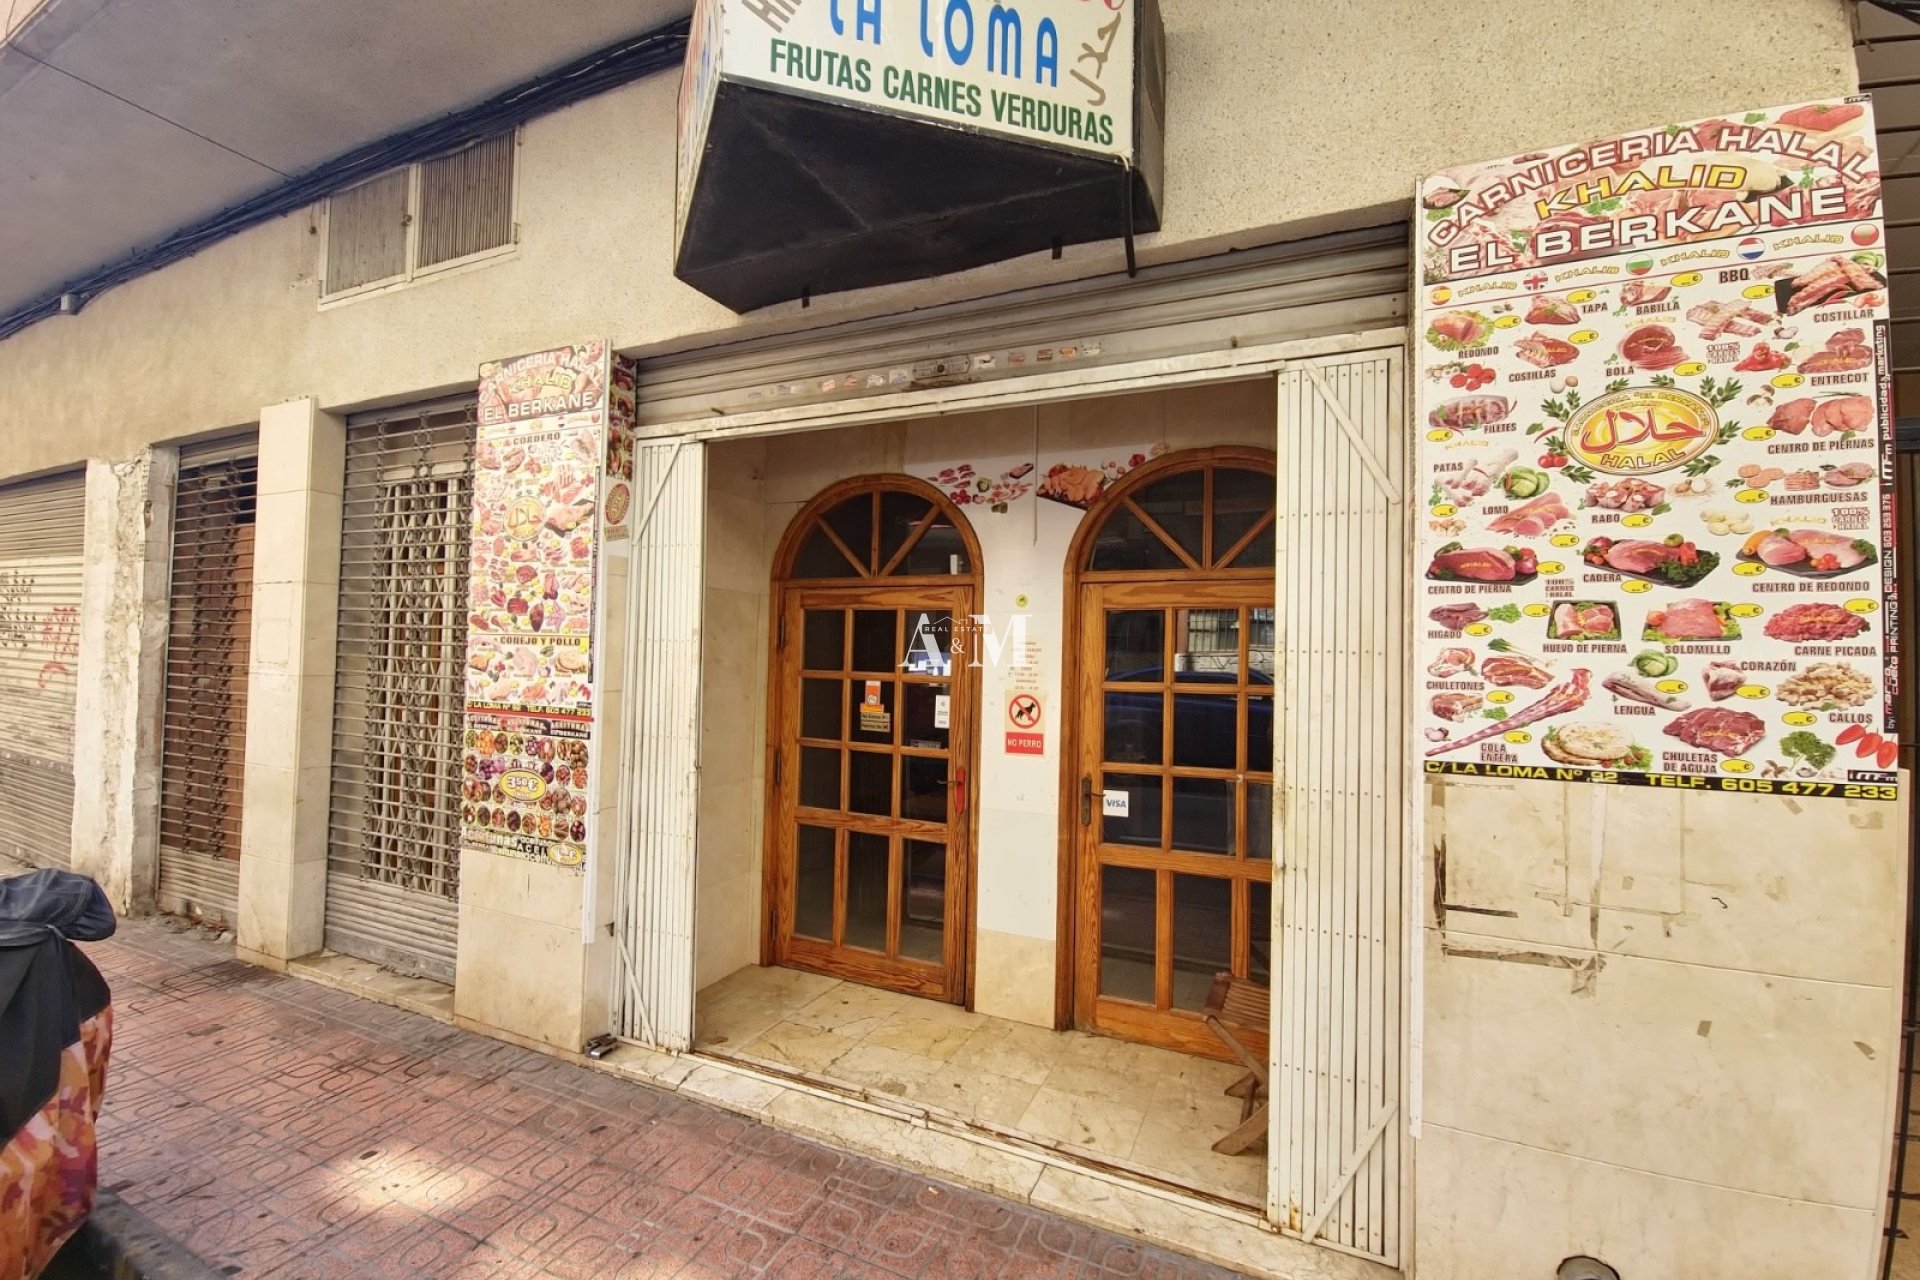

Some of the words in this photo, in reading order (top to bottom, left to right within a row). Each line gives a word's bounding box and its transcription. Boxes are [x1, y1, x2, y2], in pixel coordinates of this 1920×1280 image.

[830, 0, 882, 45] LA
[920, 0, 1058, 88] LOMA
[769, 38, 872, 93] FRUTAS
[882, 66, 982, 117] CARNES
[991, 90, 1114, 146] VERDURAS
[1428, 127, 1701, 247] CARNICERIA
[1716, 126, 1872, 184] HALAL
[1535, 164, 1748, 220] KHALID
[1449, 243, 1517, 275] EL
[1535, 187, 1849, 264] BERKANE
[1660, 248, 1731, 267] KHALID
[1772, 233, 1845, 251] KHALID
[1719, 267, 1750, 284] BBQ
[1582, 302, 1608, 314] TAPA
[1636, 301, 1680, 317] BABILLA
[1813, 308, 1875, 324] COSTILLAR
[1458, 346, 1500, 360] REDONDO
[1508, 369, 1557, 383] COSTILLAS
[1605, 365, 1635, 378] BOLA
[509, 369, 572, 394] KHALID
[1810, 372, 1869, 387] ENTRECOT
[484, 405, 503, 421] EL
[508, 390, 594, 417] BERKANE
[1484, 423, 1517, 435] FILETES
[1768, 442, 1810, 455] CENTRO
[1812, 441, 1826, 451] DE
[1829, 438, 1875, 451] PIERNAS
[1600, 449, 1687, 469] HALAL
[1433, 462, 1464, 473] PATAS
[1770, 492, 1868, 506] HAMBURGUESAS
[1482, 505, 1509, 515] LOMO
[1591, 514, 1621, 524] RABO
[1583, 573, 1623, 583] CADERA
[1428, 585, 1462, 595] CENTRO
[1464, 585, 1476, 594] DE
[1478, 584, 1513, 595] PIERNA
[1752, 582, 1796, 593] CENTRO
[1799, 581, 1813, 592] DE
[1815, 580, 1870, 592] REDONDO
[1427, 630, 1462, 639] HIGADO
[500, 636, 537, 646] CONEJO
[540, 636, 547, 646] Y
[550, 637, 581, 647] POLLO
[1543, 643, 1574, 653] HUEVO
[1576, 644, 1589, 653] DE
[1591, 644, 1627, 654] PIERNA
[1664, 644, 1731, 655] SOLOMILLO
[1794, 646, 1832, 657] CARNE
[1835, 646, 1877, 657] PICADA
[1741, 659, 1797, 672] CORAZÓN
[1426, 681, 1485, 691] CHULETONES
[1614, 705, 1655, 716] LENGUA
[1829, 712, 1873, 724] CALLOS
[1007, 738, 1016, 747] NO
[1018, 739, 1042, 748] PERRO
[1480, 743, 1507, 752] COLA
[1480, 752, 1518, 763] ENTERA
[1662, 751, 1718, 763] CHULETAS
[1663, 762, 1681, 773] DE
[1683, 763, 1718, 775] AGUJA
[1425, 762, 1445, 774] C/
[1451, 763, 1479, 775] LA
[1486, 765, 1549, 780] LOMA
[1644, 774, 1711, 790] TELF.
[1721, 778, 1774, 793] 605
[1781, 782, 1835, 796] 477
[1844, 784, 1897, 800] 233
[1106, 799, 1127, 809] VISA
